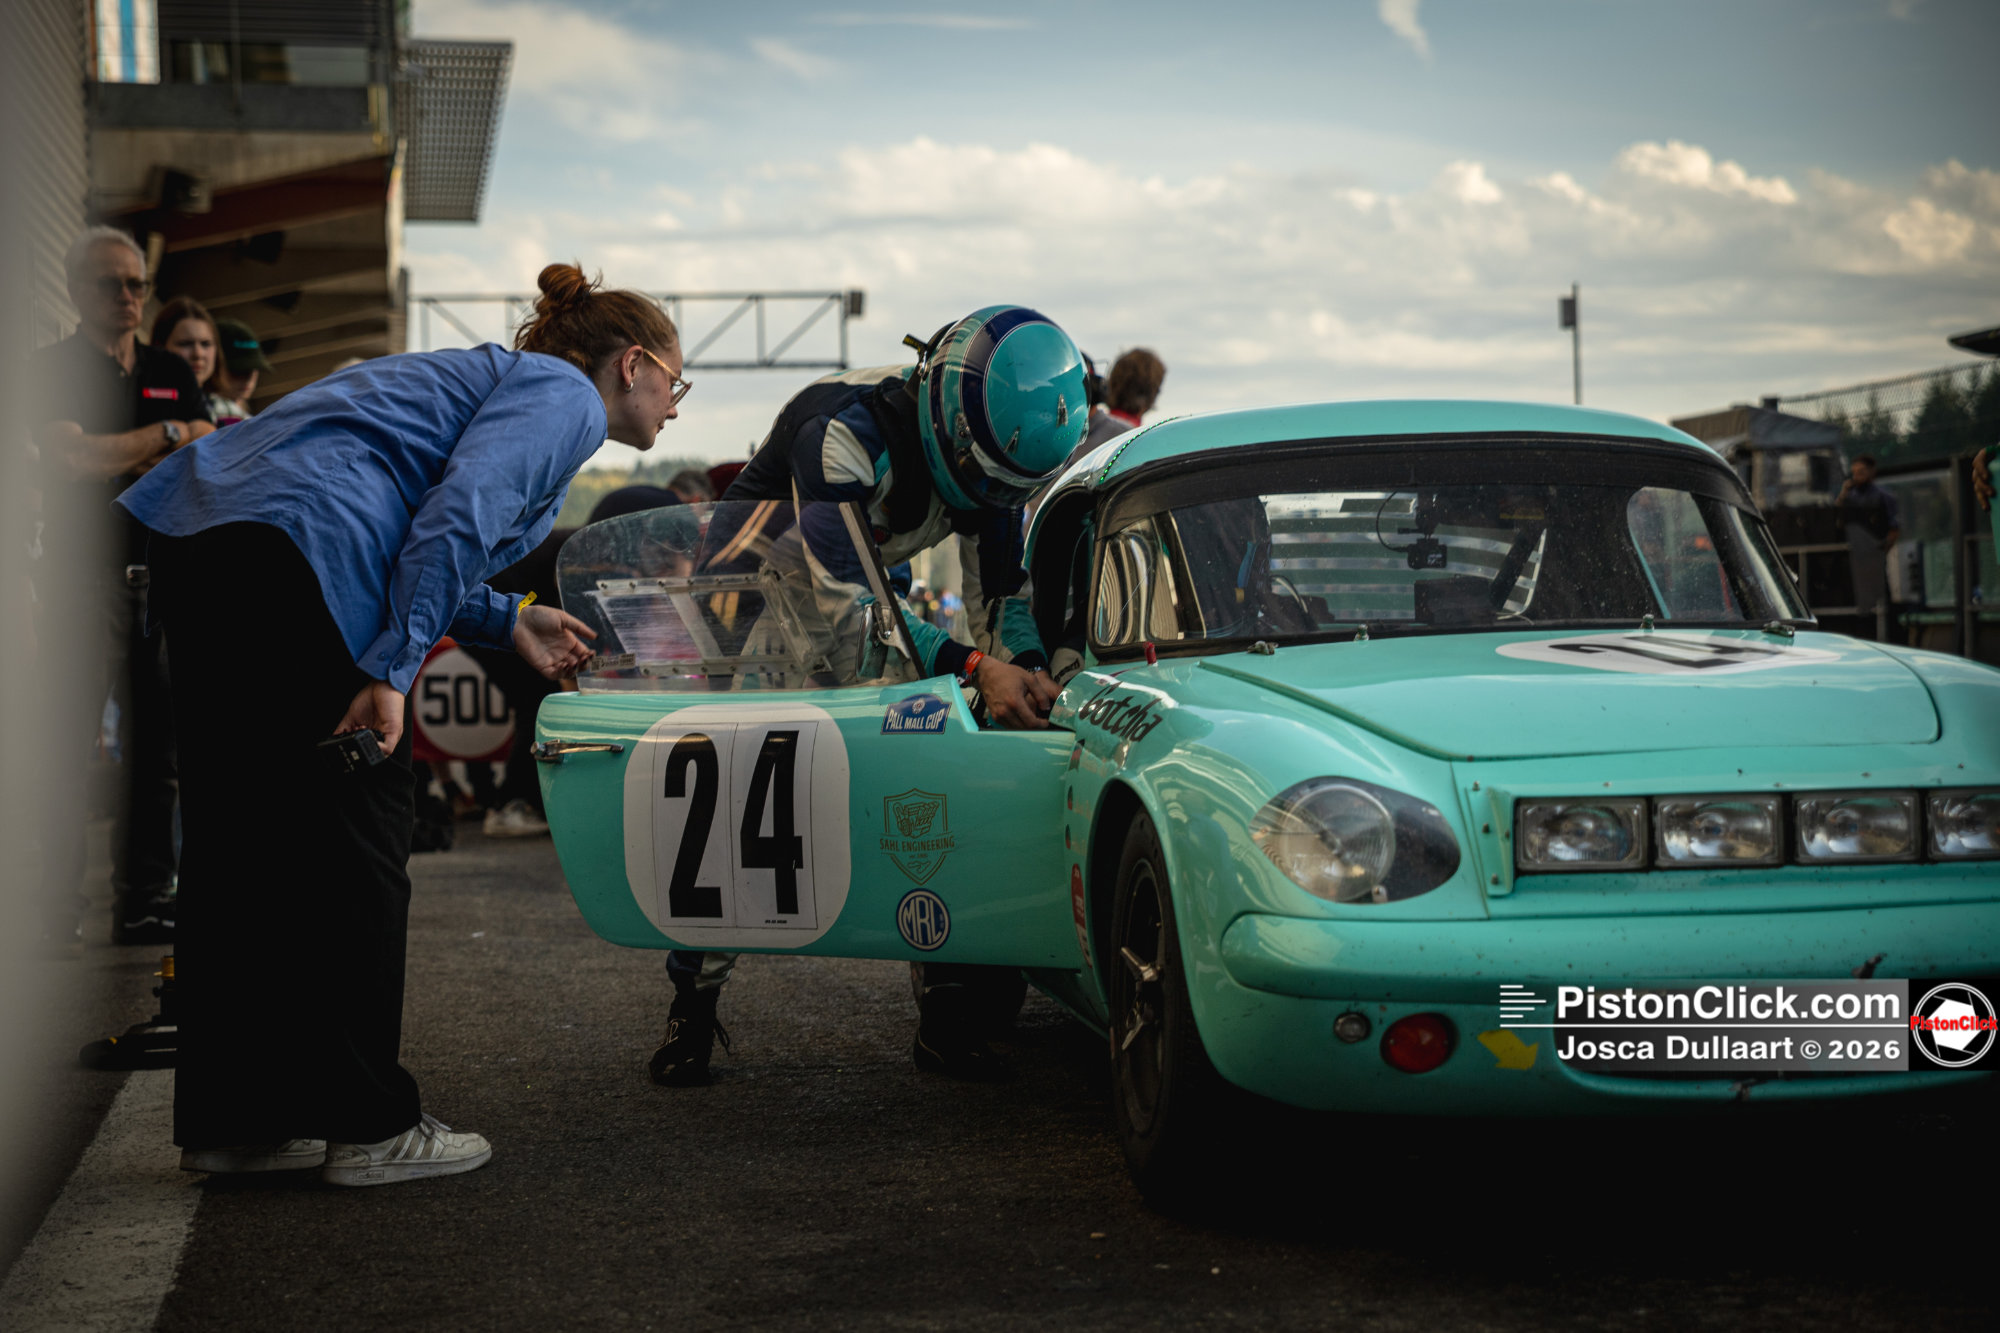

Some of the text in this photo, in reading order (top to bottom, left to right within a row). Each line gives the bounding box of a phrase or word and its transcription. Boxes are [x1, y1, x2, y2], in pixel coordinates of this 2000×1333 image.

[885, 708, 946, 730] PALL MALL CUP
[663, 729, 804, 919] 24
[879, 834, 955, 852] SAHL ENGINEERING
[902, 896, 943, 945] MRL
